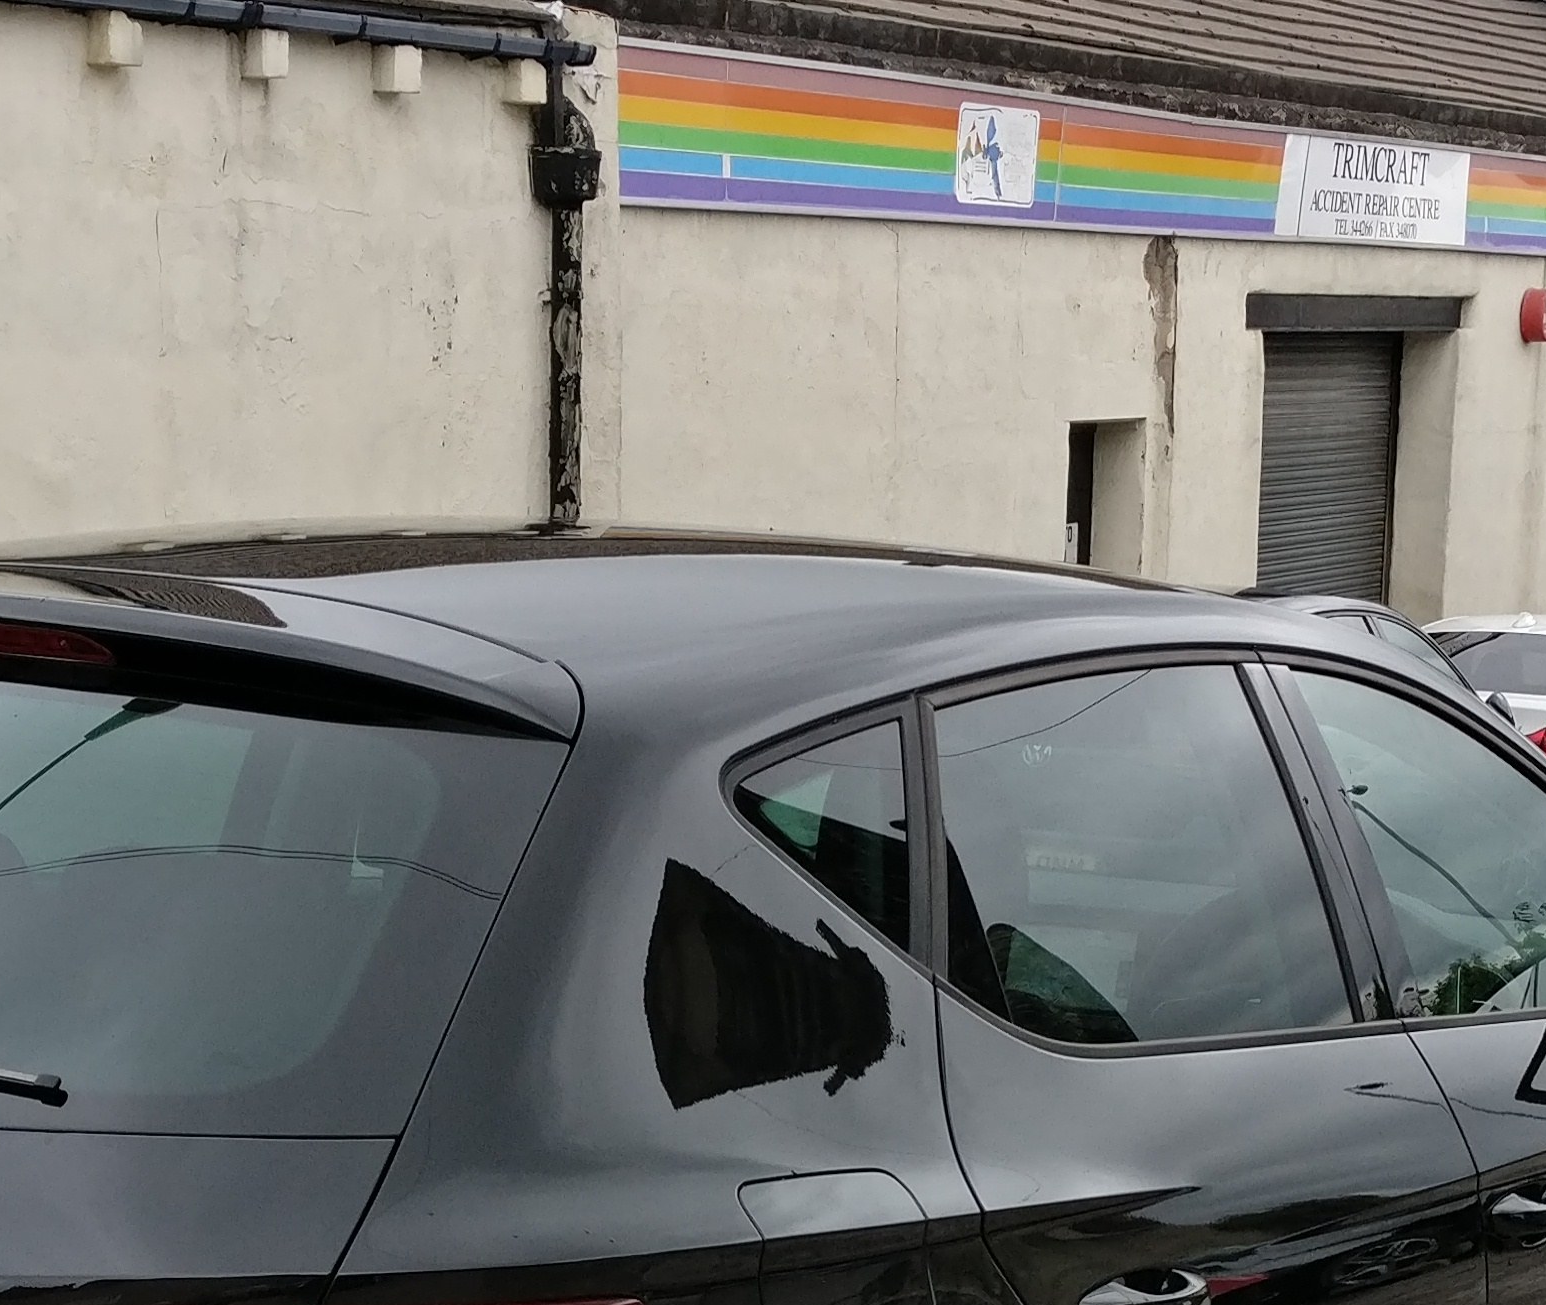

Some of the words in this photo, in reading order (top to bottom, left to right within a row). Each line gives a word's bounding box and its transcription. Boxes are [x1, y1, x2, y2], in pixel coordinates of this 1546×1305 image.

[1332, 142, 1431, 187] TRIMCRAFT
[1310, 188, 1363, 215] ACCIDENT
[1363, 193, 1400, 217] REPAIR
[1401, 196, 1441, 220] CENTRE
[1334, 218, 1350, 236] TEL
[1379, 221, 1395, 238] FAX
